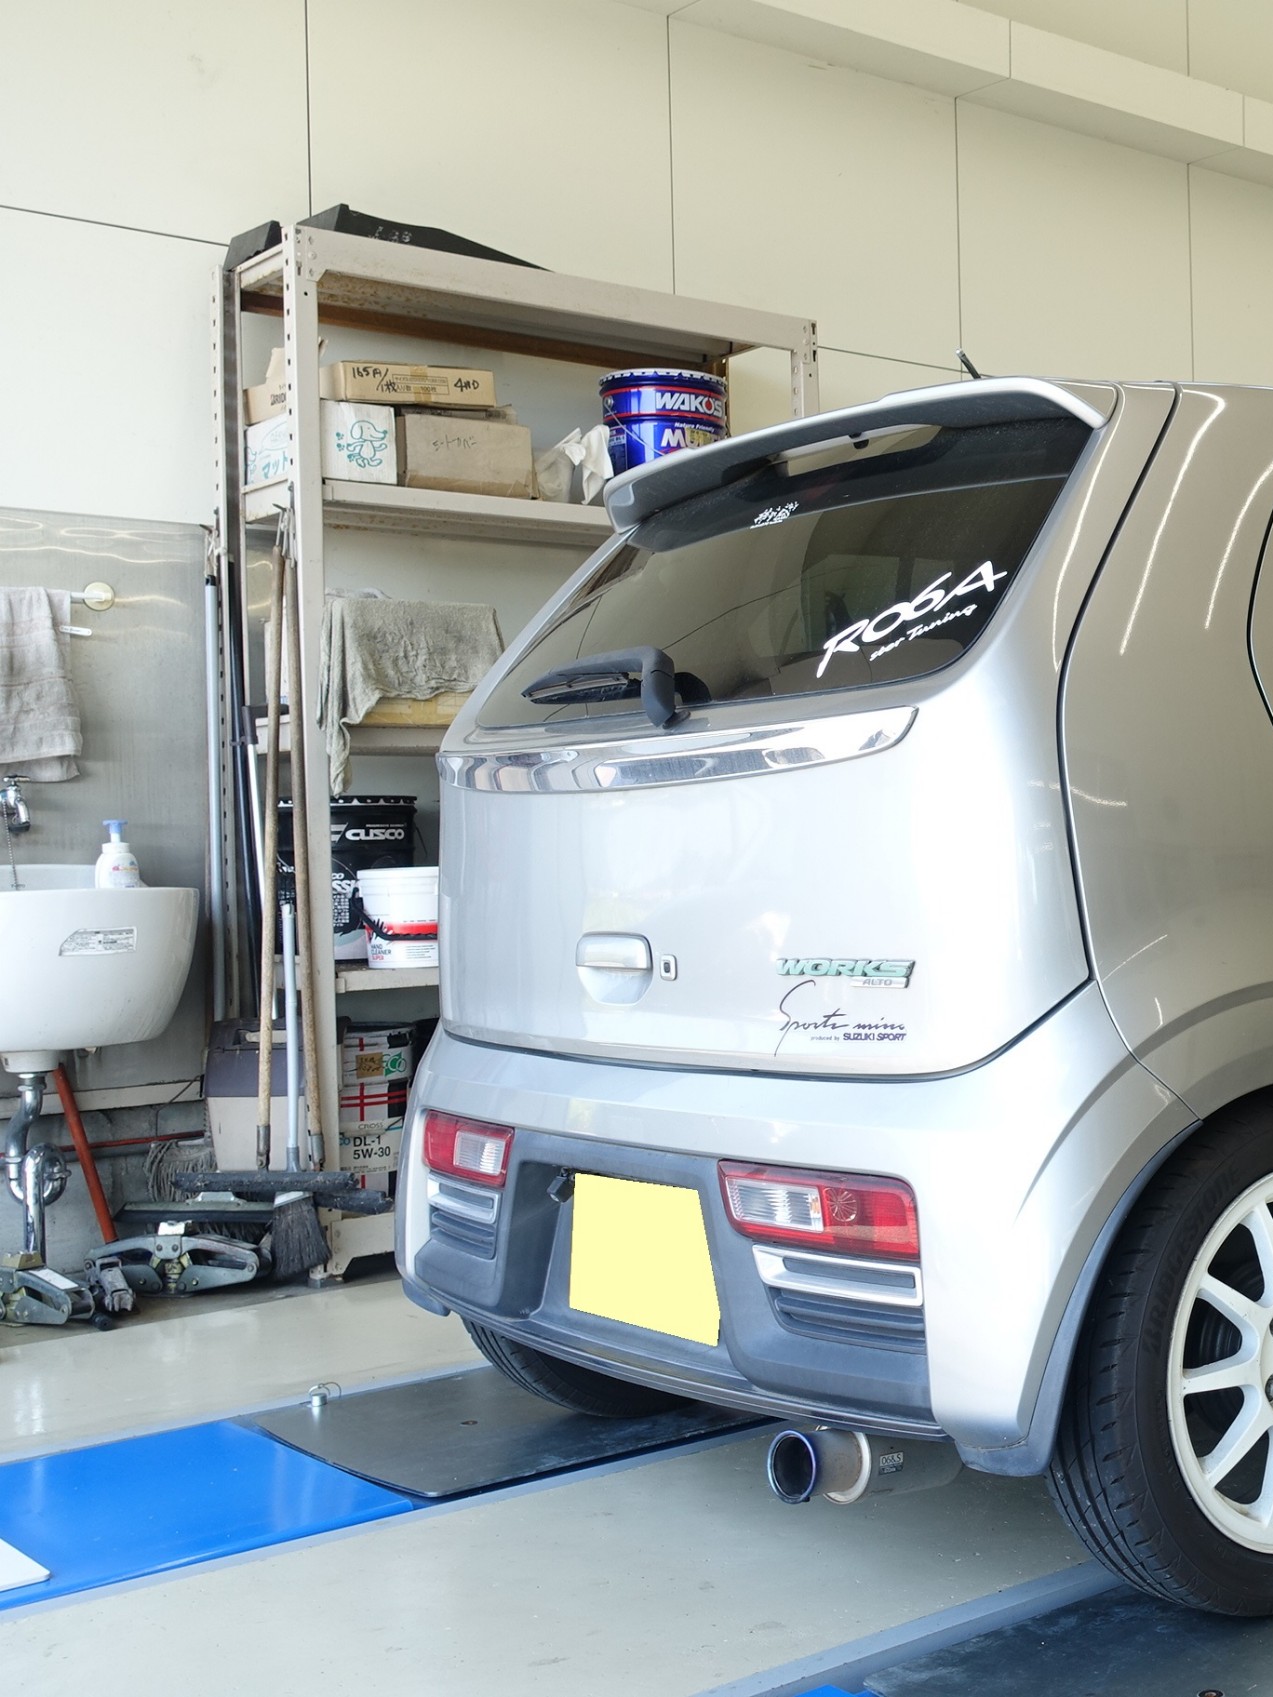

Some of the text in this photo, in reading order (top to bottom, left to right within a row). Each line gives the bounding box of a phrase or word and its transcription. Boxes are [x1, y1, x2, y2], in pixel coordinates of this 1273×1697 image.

[655, 392, 724, 418] WAKO'S
[906, 603, 978, 641] Tuning
[345, 828, 405, 840] CUSCO
[776, 957, 916, 977] WORKS
[862, 978, 893, 986] ALTO
[852, 1016, 905, 1030] mini
[843, 1032, 876, 1041] SUZUKI
[876, 1032, 906, 1041] SPORT
[353, 1134, 381, 1147] DL-1
[353, 1146, 391, 1160] 5W-30
